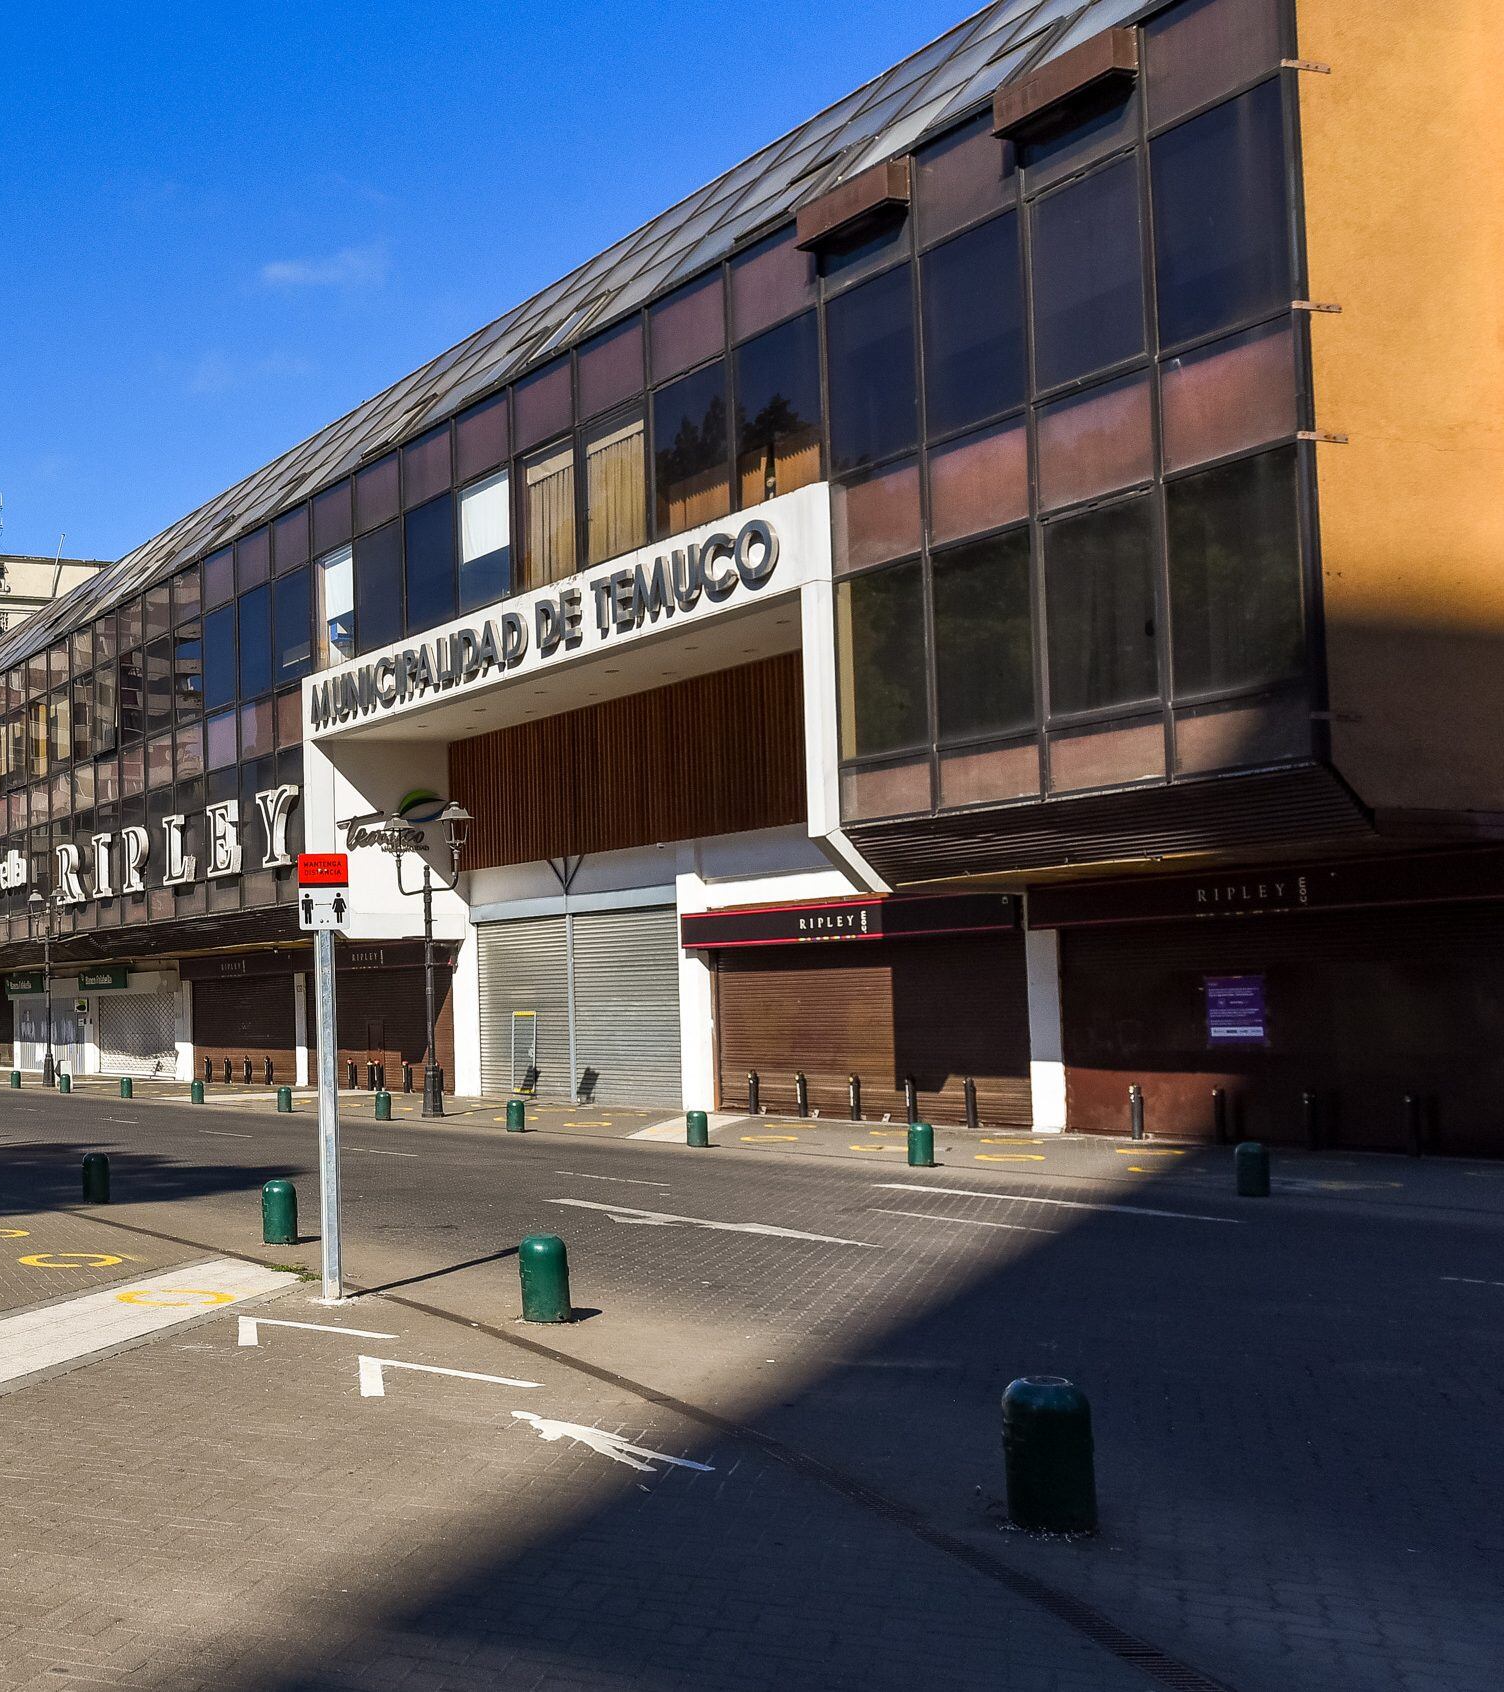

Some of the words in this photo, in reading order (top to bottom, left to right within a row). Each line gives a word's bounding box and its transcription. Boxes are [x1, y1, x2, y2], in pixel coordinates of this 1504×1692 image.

[311, 612, 529, 729] MUNICIPALIDAD
[535, 588, 582, 654] DE
[590, 519, 780, 636] TEMUCO
[56, 784, 299, 905] RIPLEY
[1198, 883, 1285, 902] RIPLEY
[799, 915, 854, 930] RIPLEY
[351, 952, 378, 962] RIPLEY
